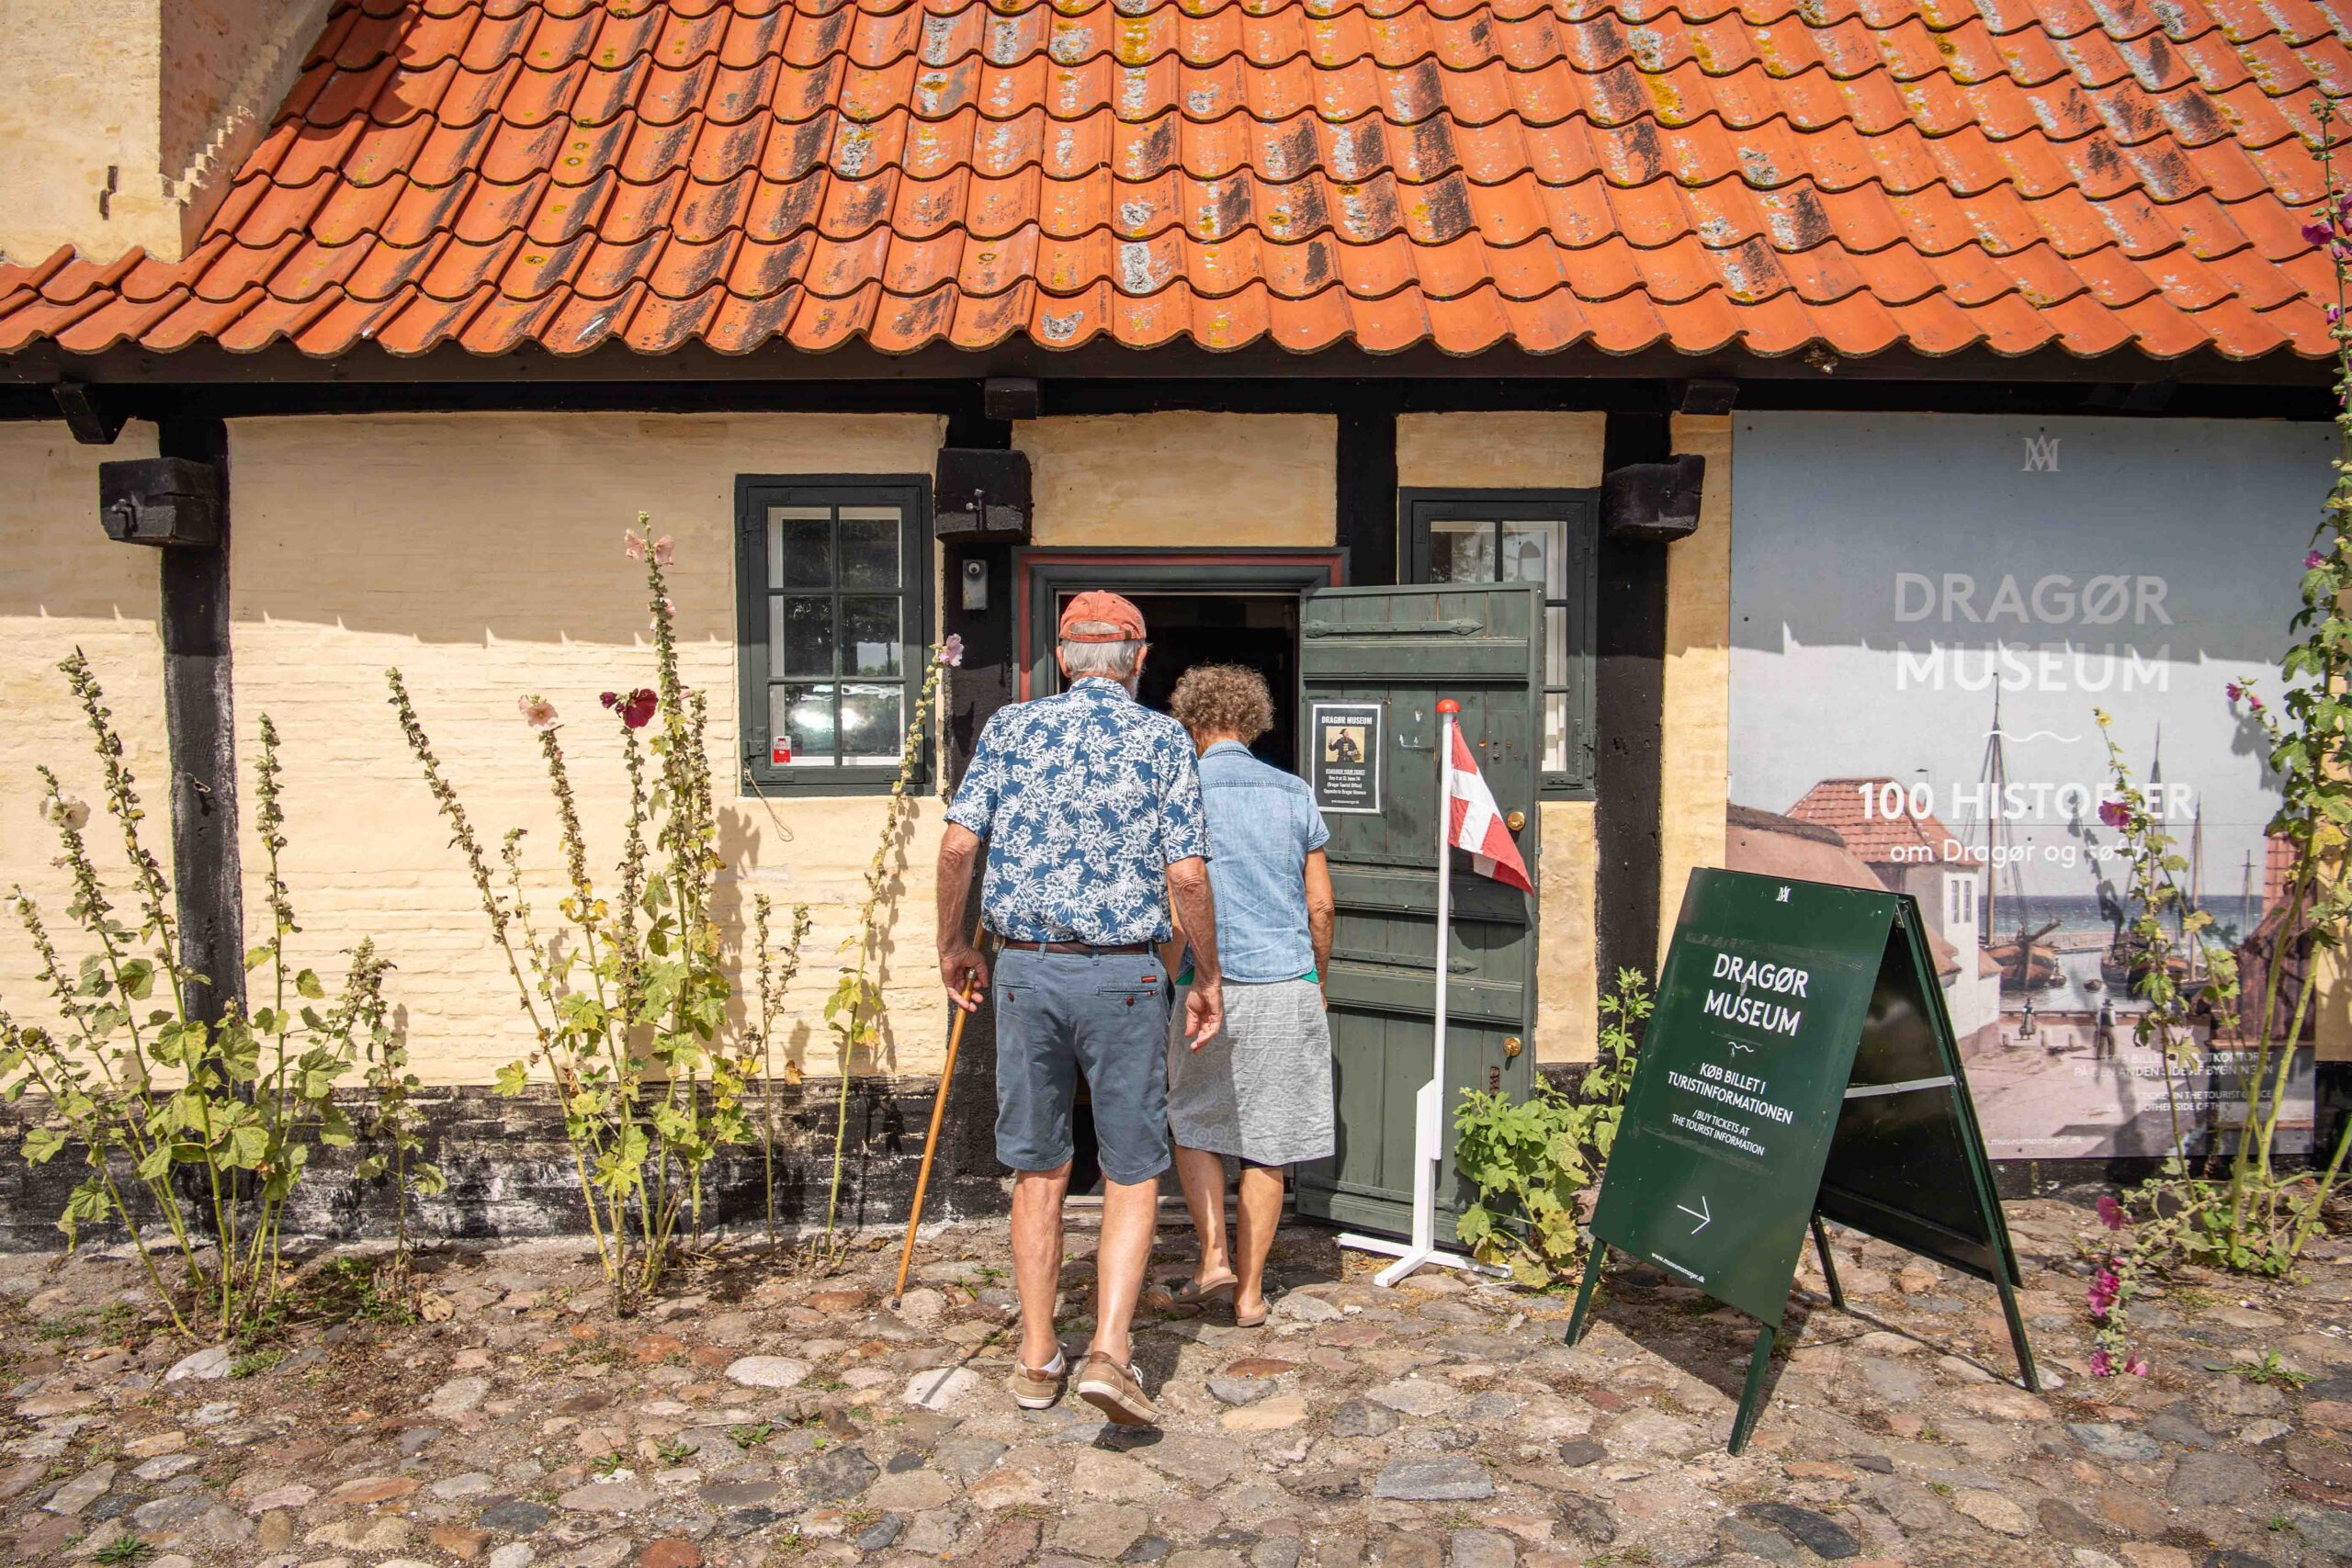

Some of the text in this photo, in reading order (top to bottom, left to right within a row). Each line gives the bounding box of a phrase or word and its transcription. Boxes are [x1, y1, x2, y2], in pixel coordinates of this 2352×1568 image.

[1894, 572, 2175, 626] DRAGØR
[1896, 640, 2170, 693] MUSEUM
[1346, 716, 1373, 725] MUSEUM
[1858, 782, 1934, 820] 100
[1890, 843, 1933, 862] om
[1943, 838, 2036, 870] Dragør
[2044, 843, 2076, 869] og
[1713, 953, 1809, 998] DRAGØR
[1703, 989, 1801, 1036] MUSEUM
[1668, 1071, 1793, 1124] TURISTINFORMATIONEN
[1700, 1062, 1767, 1095] KØB BILLET I
[1671, 1113, 1765, 1156] THE TOURIST INFORMATION
[1712, 1115, 1739, 1133] TICKETS
[1738, 1126, 1750, 1137] AT
